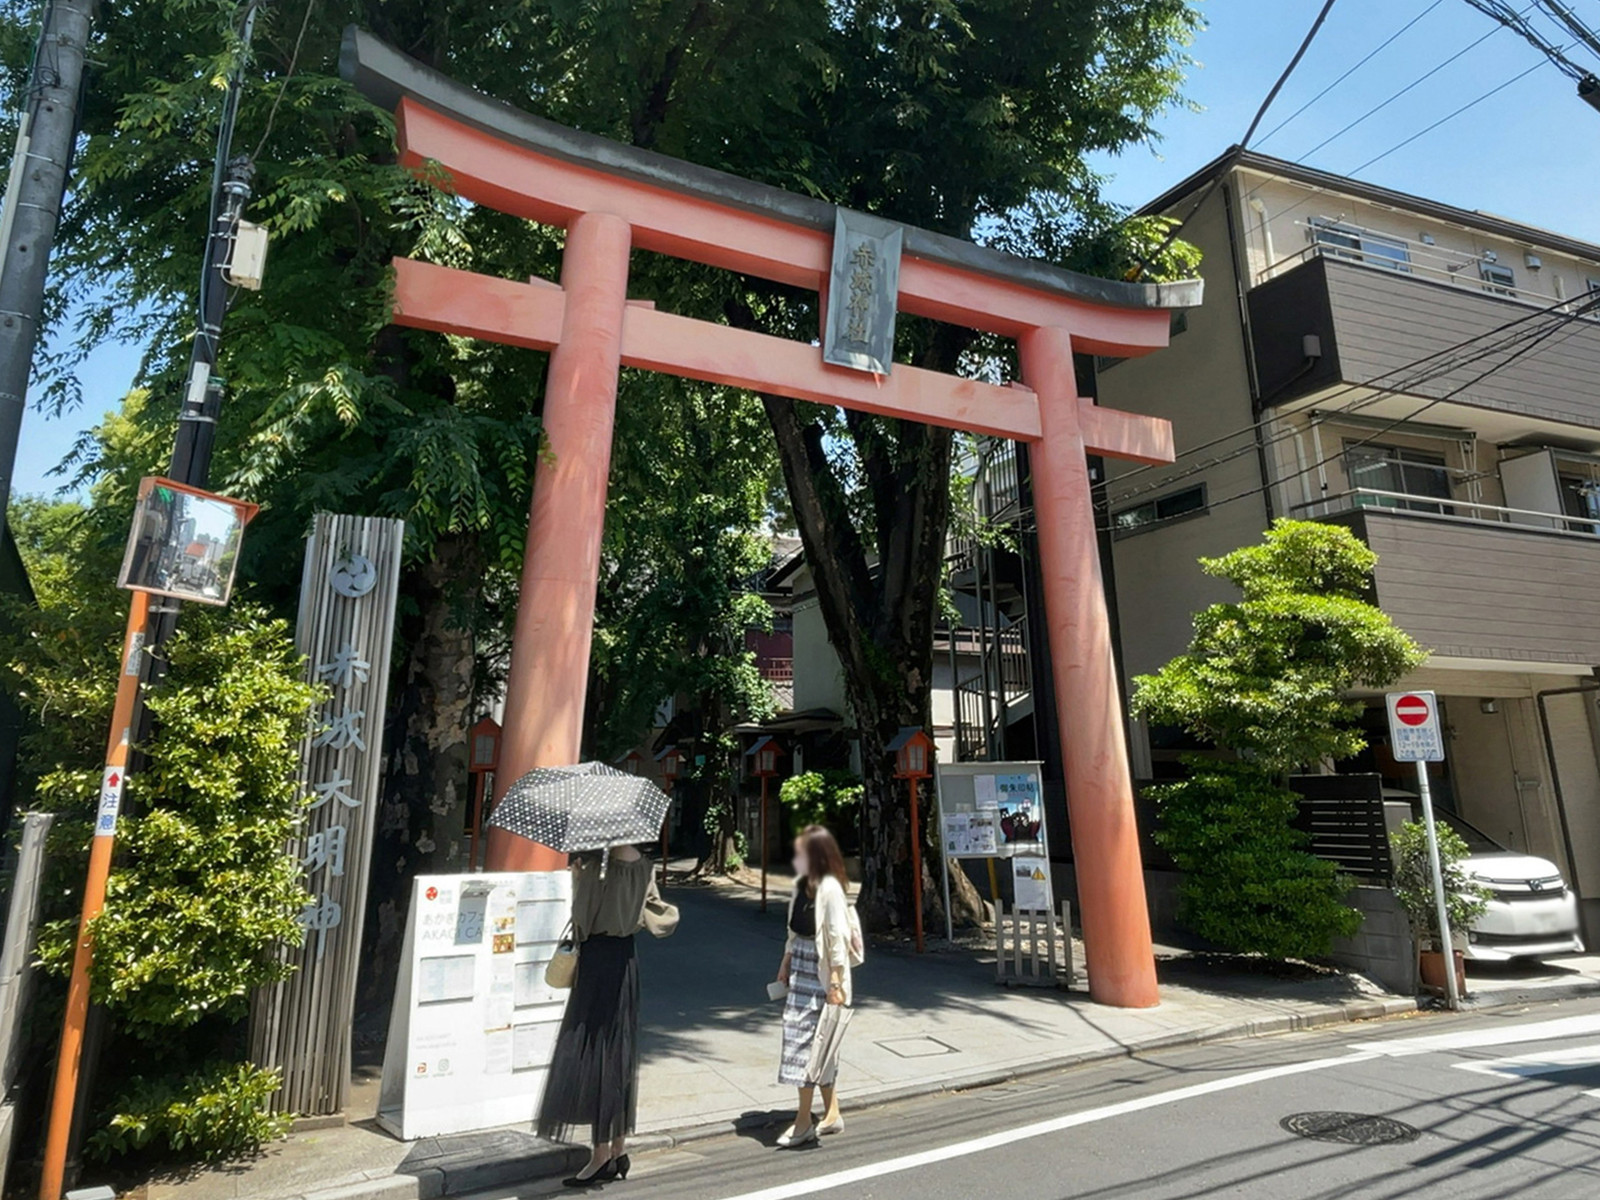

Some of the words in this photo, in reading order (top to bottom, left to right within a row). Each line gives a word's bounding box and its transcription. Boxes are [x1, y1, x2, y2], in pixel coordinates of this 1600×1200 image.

[99, 792, 119, 830] 注意
[295, 641, 371, 960] 赤城大明神
[421, 926, 461, 941] AKAGI
